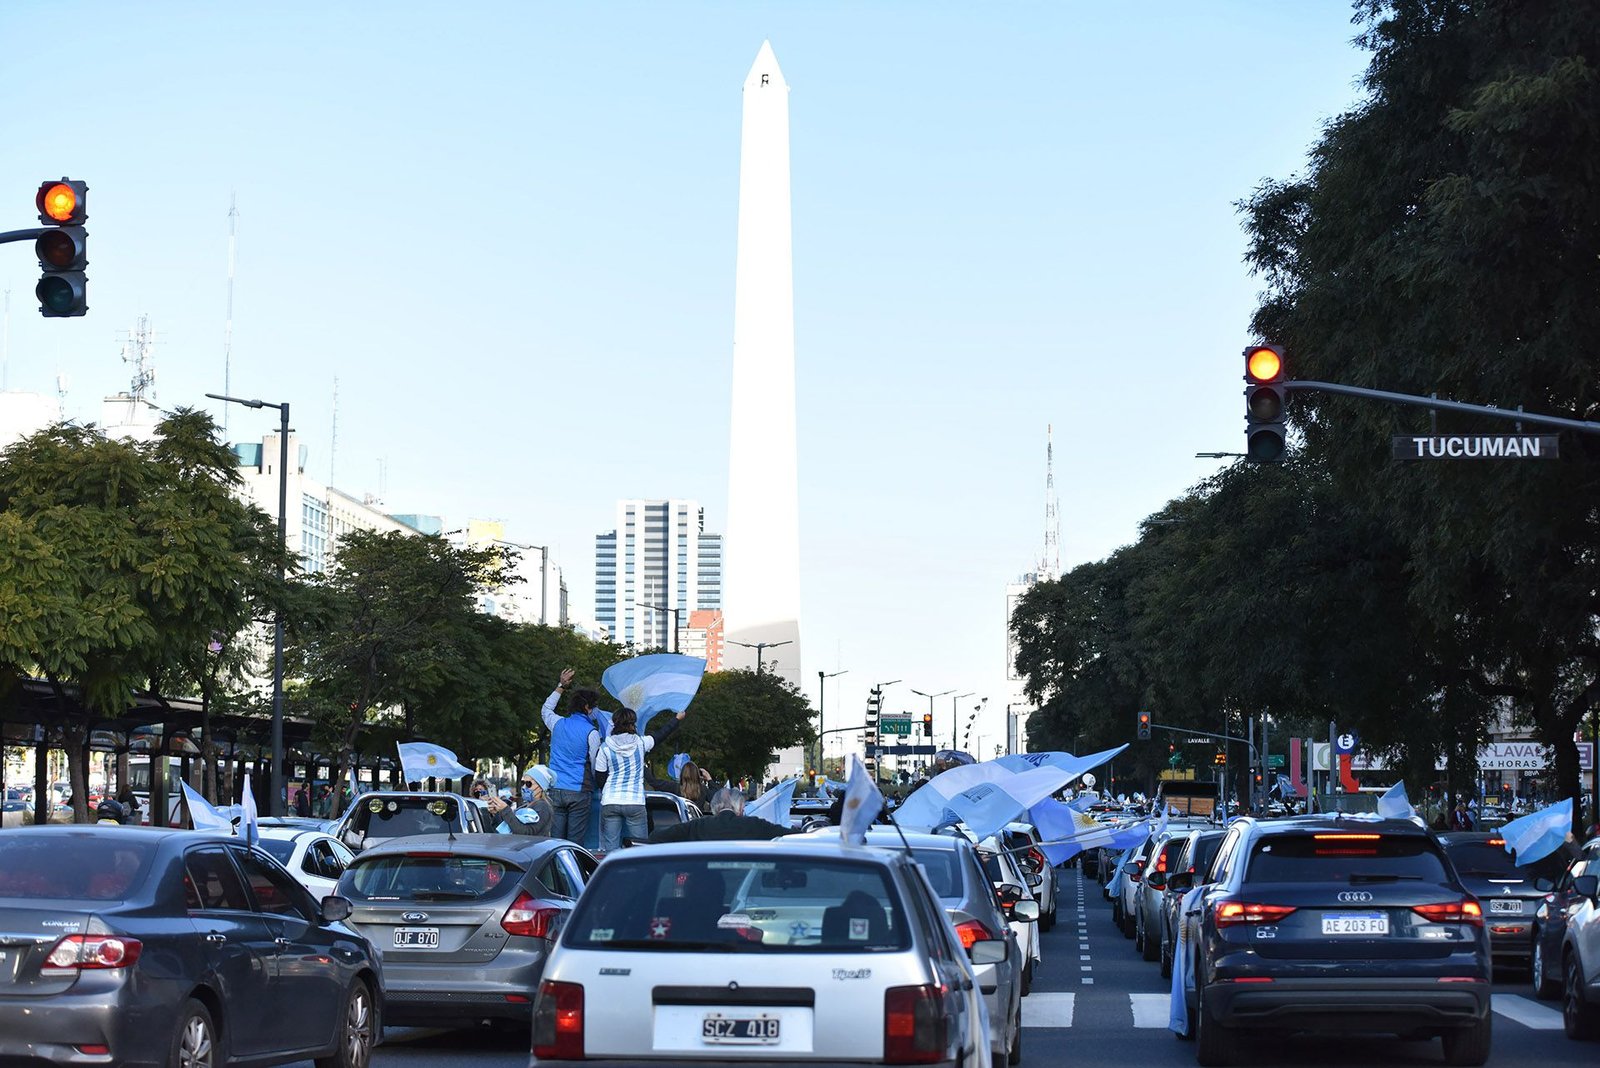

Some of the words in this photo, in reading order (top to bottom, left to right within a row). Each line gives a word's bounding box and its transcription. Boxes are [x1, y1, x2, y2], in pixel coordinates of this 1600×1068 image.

[1412, 437, 1540, 457] TUCUMAN
[1482, 760, 1494, 768] 24
[1498, 760, 1538, 768] HORAS
[1507, 902, 1521, 910] 701
[1325, 920, 1341, 932] AE
[1344, 920, 1367, 932] 203
[395, 932, 413, 944] OJF
[418, 932, 437, 944] 870
[704, 1020, 736, 1037] SCZ
[746, 1020, 778, 1037] 418
